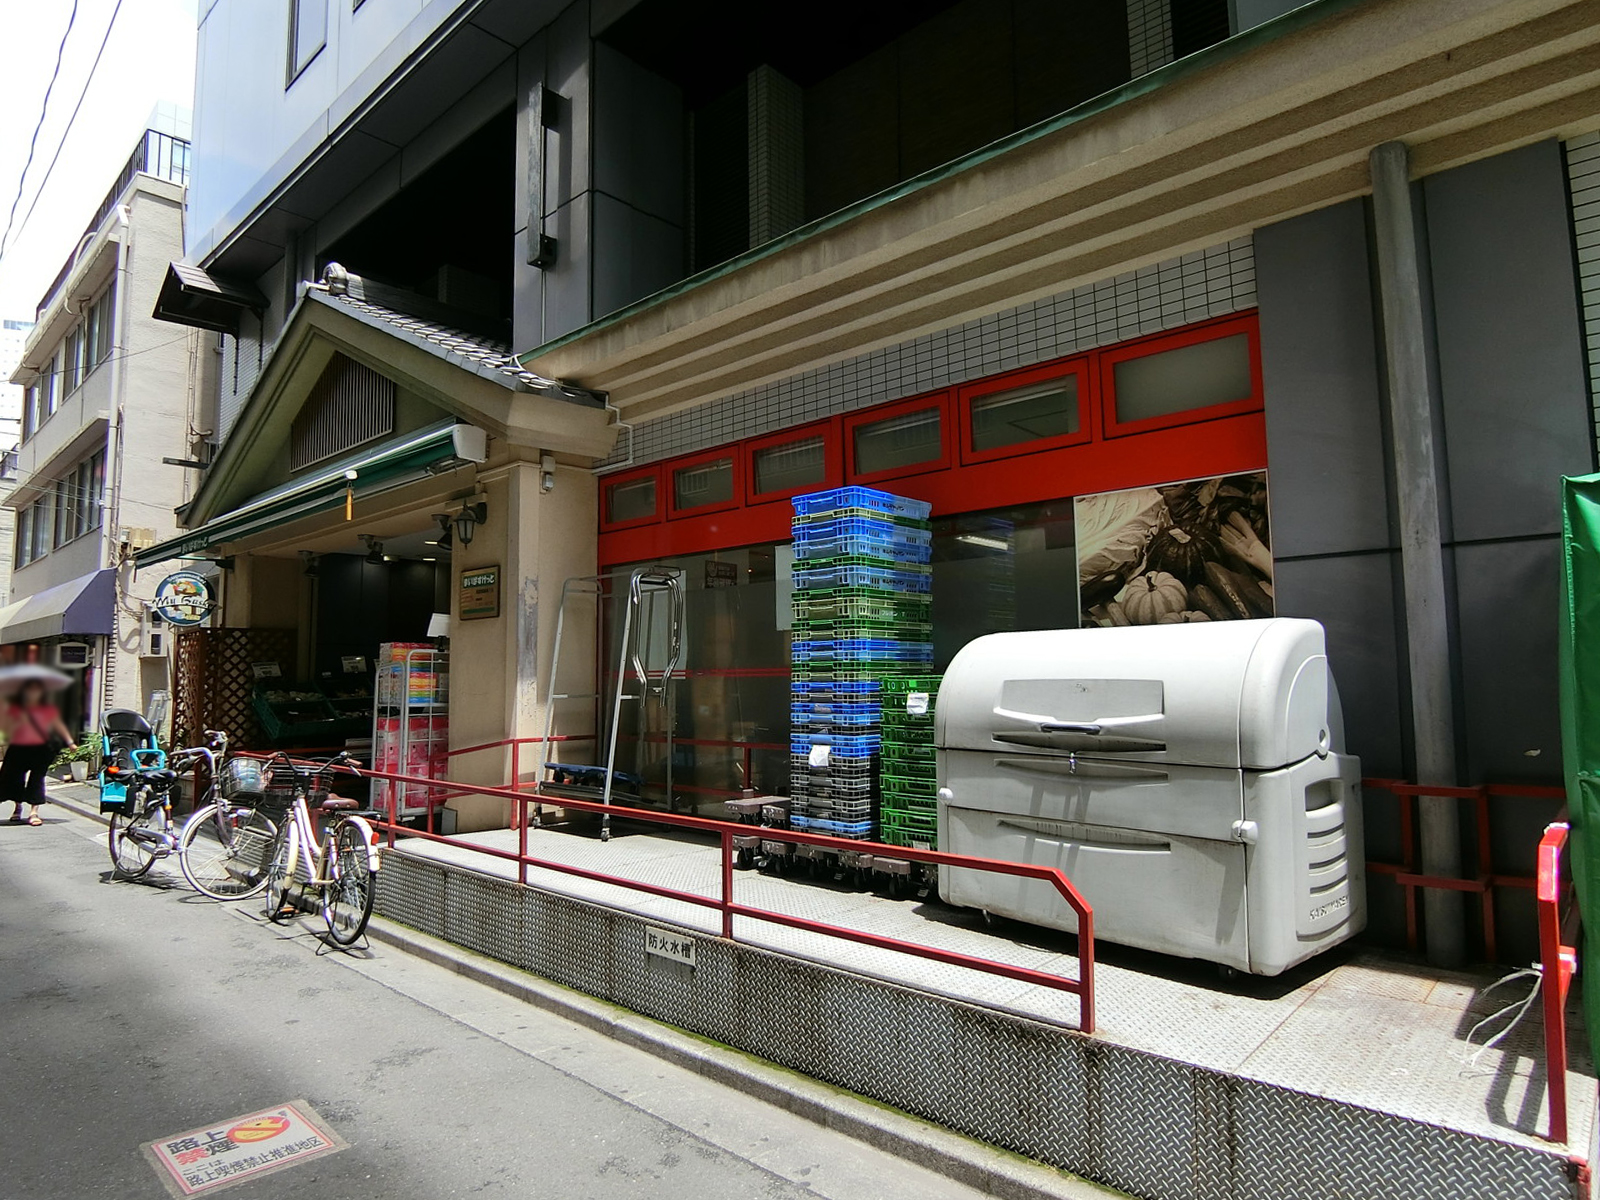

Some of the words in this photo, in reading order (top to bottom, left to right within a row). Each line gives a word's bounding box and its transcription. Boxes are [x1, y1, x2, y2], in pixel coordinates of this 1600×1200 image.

[648, 934, 692, 958] 防火水槽
[166, 1130, 229, 1155] 路上
[174, 1139, 241, 1166] 禁煙
[182, 1159, 226, 1176] ここは
[186, 1135, 325, 1187] 路上喫煙禁止推進地区
